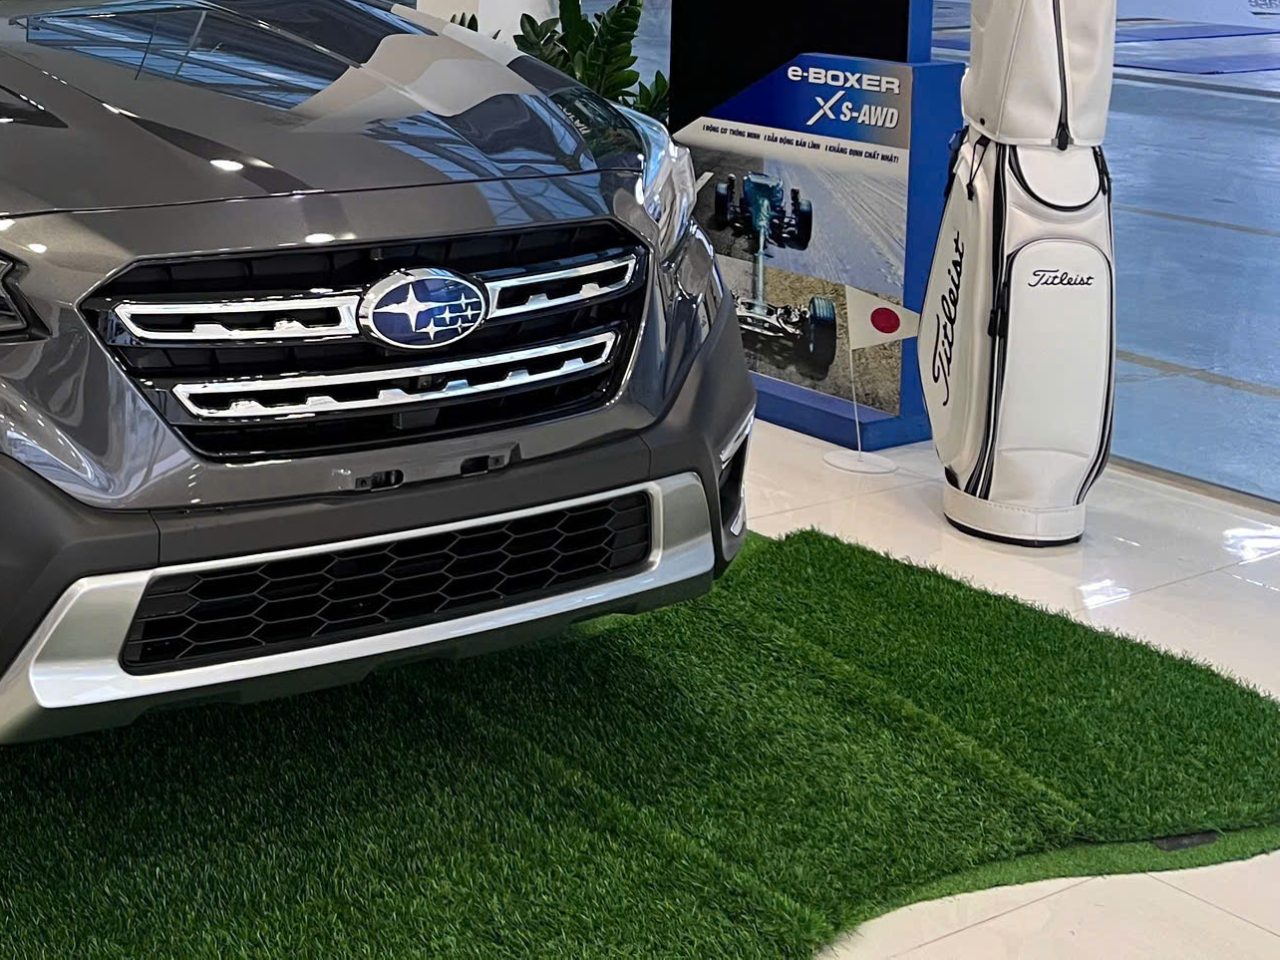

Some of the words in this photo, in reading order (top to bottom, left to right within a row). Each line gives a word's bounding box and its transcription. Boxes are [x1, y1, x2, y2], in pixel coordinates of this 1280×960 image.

[787, 66, 900, 94] e-BOXER
[840, 101, 899, 129] S-AWD
[1028, 269, 1095, 287] Titleist
[932, 231, 964, 406] Titleist
